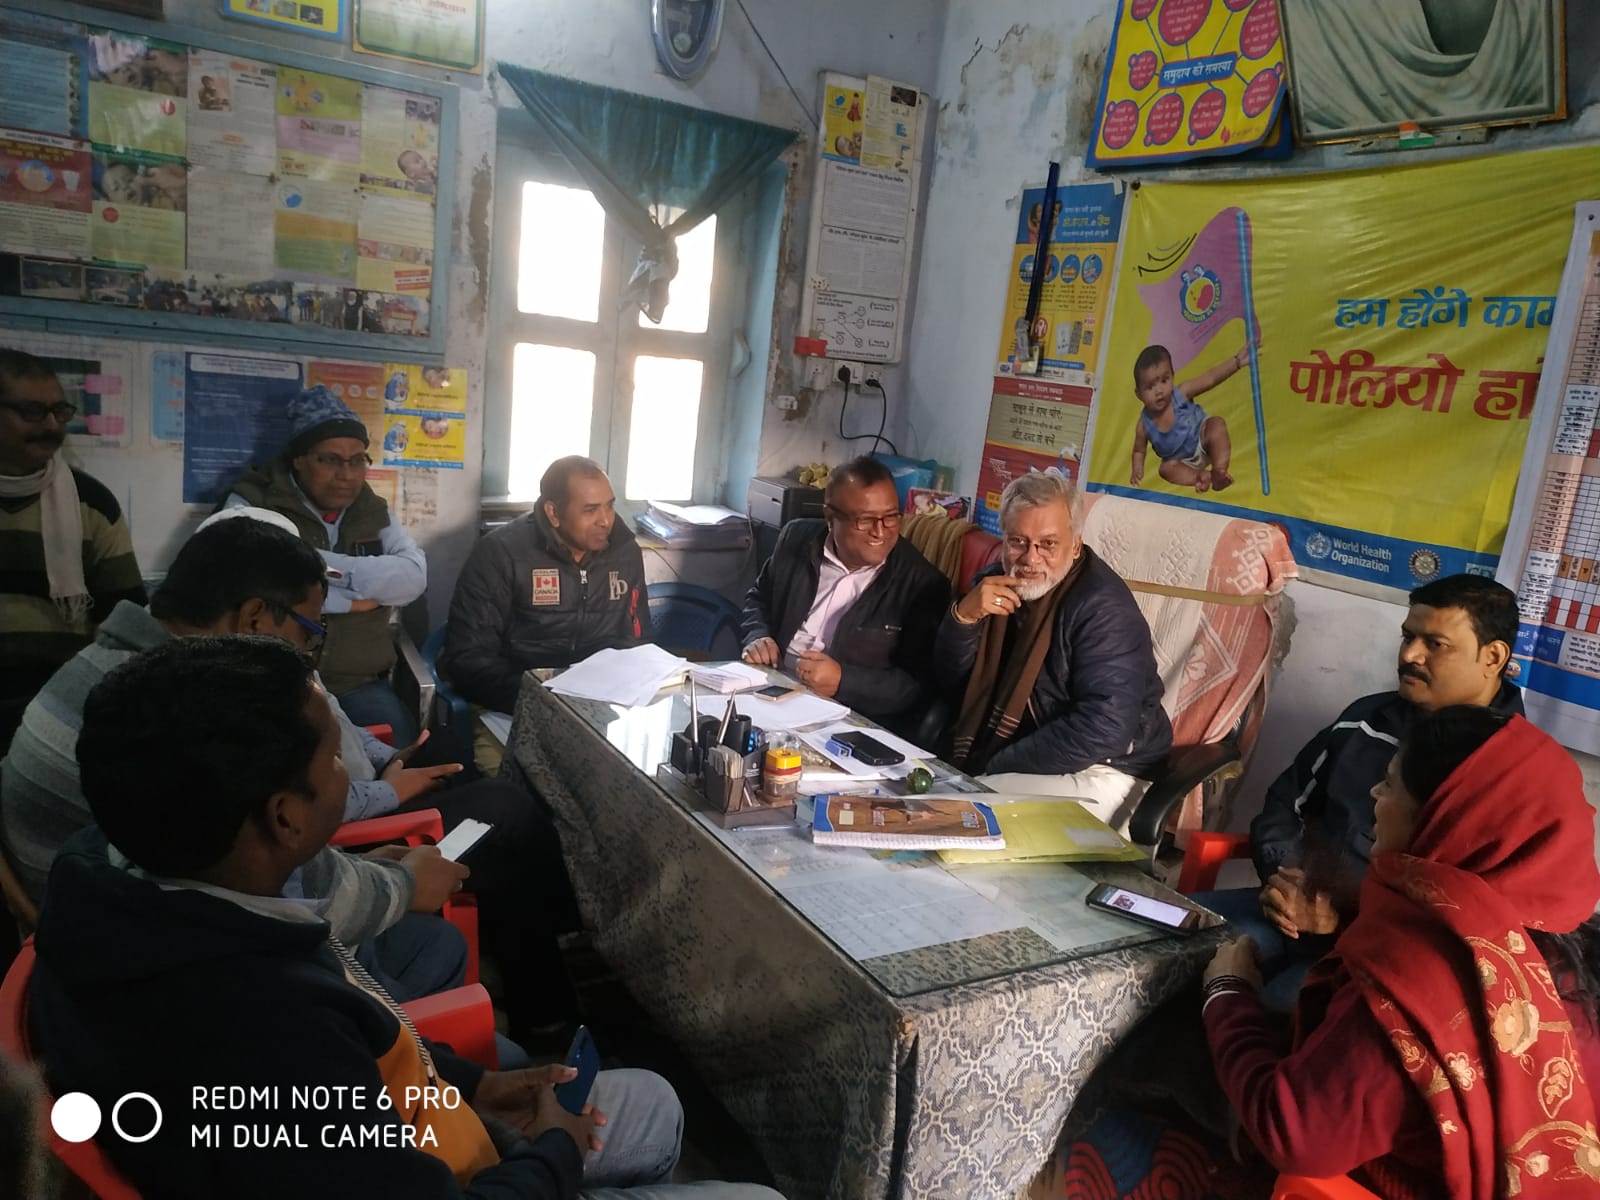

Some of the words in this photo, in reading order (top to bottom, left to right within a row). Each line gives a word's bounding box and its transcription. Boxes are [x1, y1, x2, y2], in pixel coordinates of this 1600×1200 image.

[1334, 299, 1390, 328] हम
[1397, 285, 1472, 328] होंगे
[1289, 350, 1465, 413] पोलियो
[1331, 551, 1390, 572] Organization
[1333, 538, 1359, 553] World
[1361, 543, 1392, 561] Health
